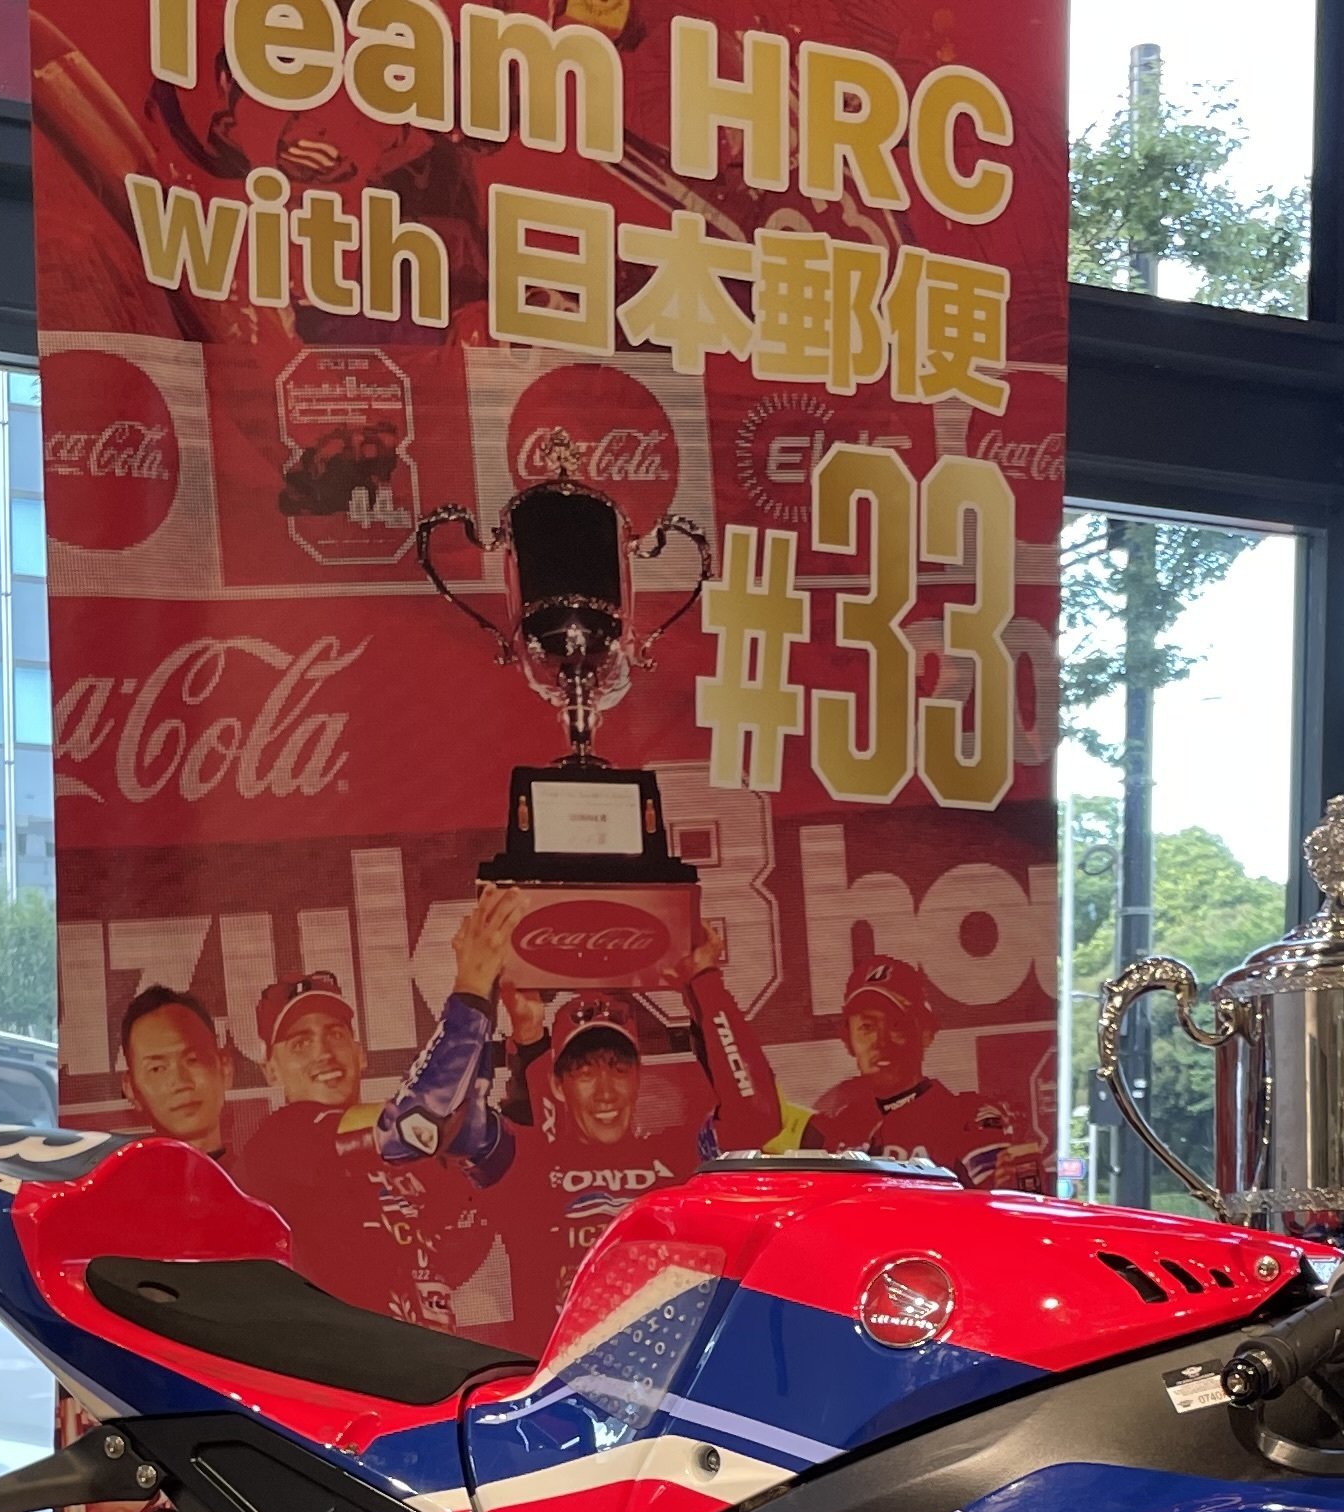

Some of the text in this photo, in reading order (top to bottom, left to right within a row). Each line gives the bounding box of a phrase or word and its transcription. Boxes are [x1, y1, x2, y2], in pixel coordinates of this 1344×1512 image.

[672, 15, 1013, 226] HRC
[125, 170, 1011, 415] with 日本郵便
[695, 443, 1016, 812] #33
[519, 927, 657, 951] Coca-Cola
[799, 824, 1057, 1018] ho
[713, 1010, 755, 1098] TAICHI
